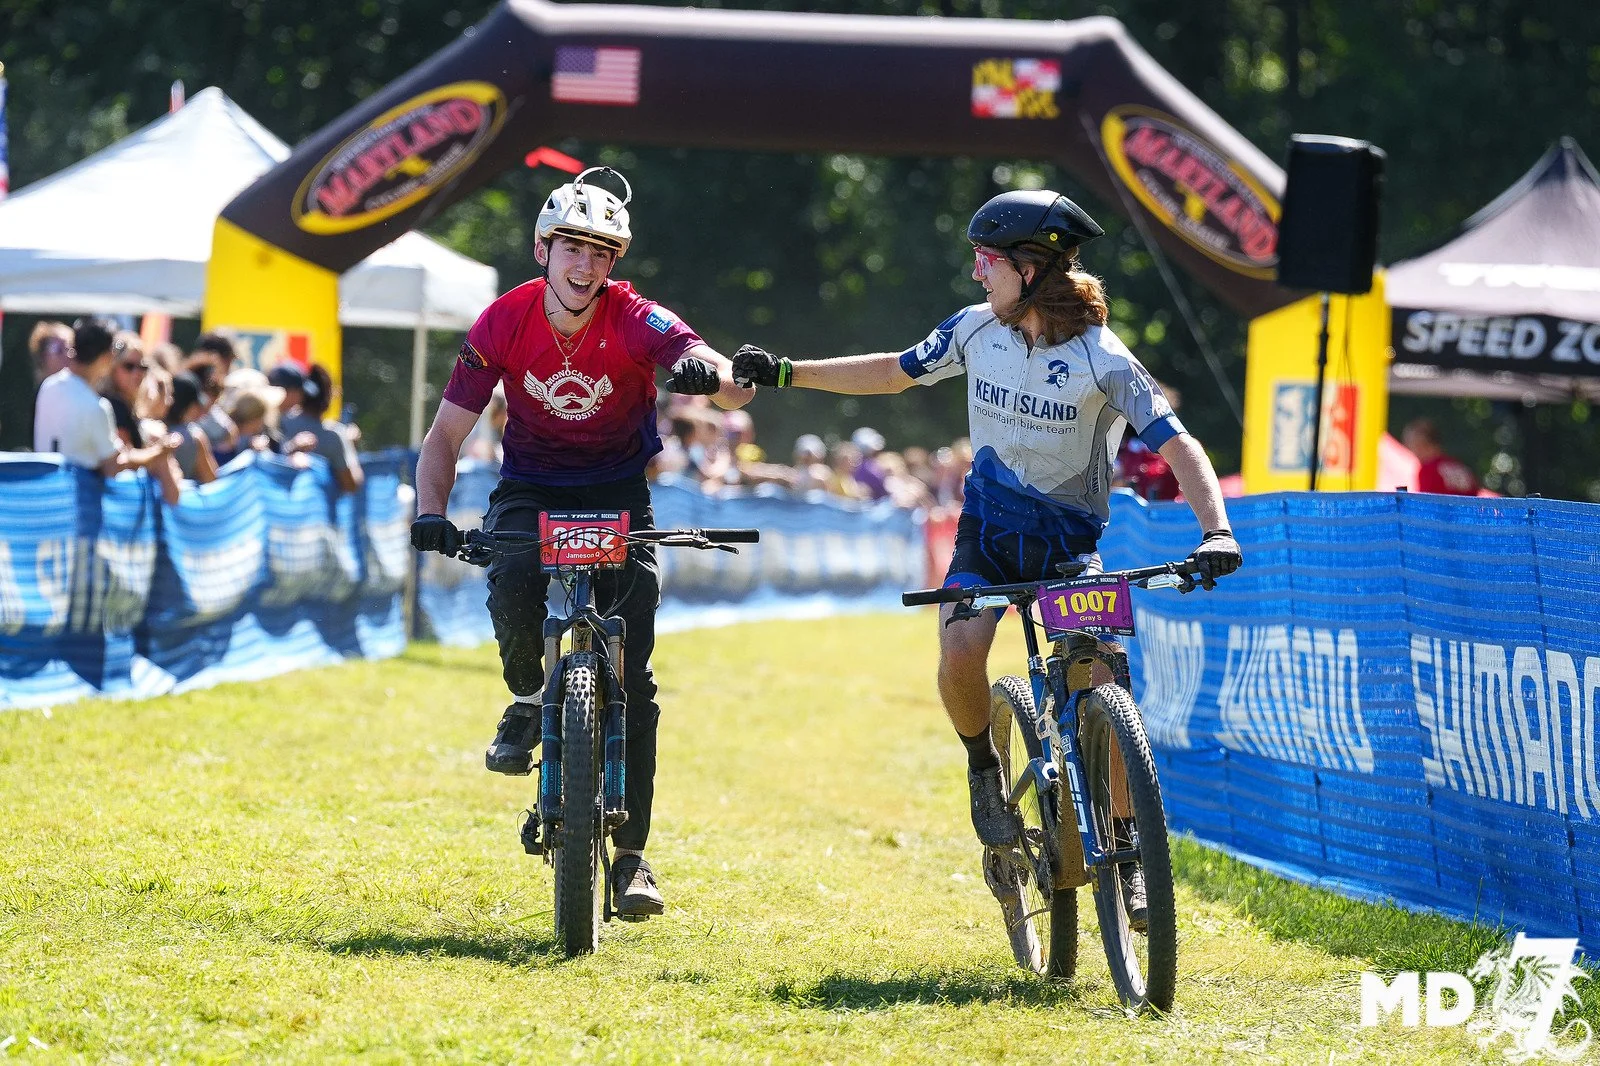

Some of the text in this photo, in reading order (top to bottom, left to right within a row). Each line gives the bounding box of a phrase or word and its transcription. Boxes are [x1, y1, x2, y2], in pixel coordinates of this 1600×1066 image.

[317, 98, 481, 216] MARYLAND
[1124, 126, 1279, 261] MARYLAND
[650, 315, 667, 330] NICA
[1402, 311, 1548, 359] SPEED
[544, 369, 596, 387] MONOCACY
[550, 405, 601, 420] COMPOSITE
[975, 378, 1077, 421] KENT ISLAND
[974, 404, 1076, 435] mountain bike team
[1069, 578, 1097, 586] TREK
[1054, 590, 1117, 617] 1007
[1079, 614, 1096, 622] Gray
